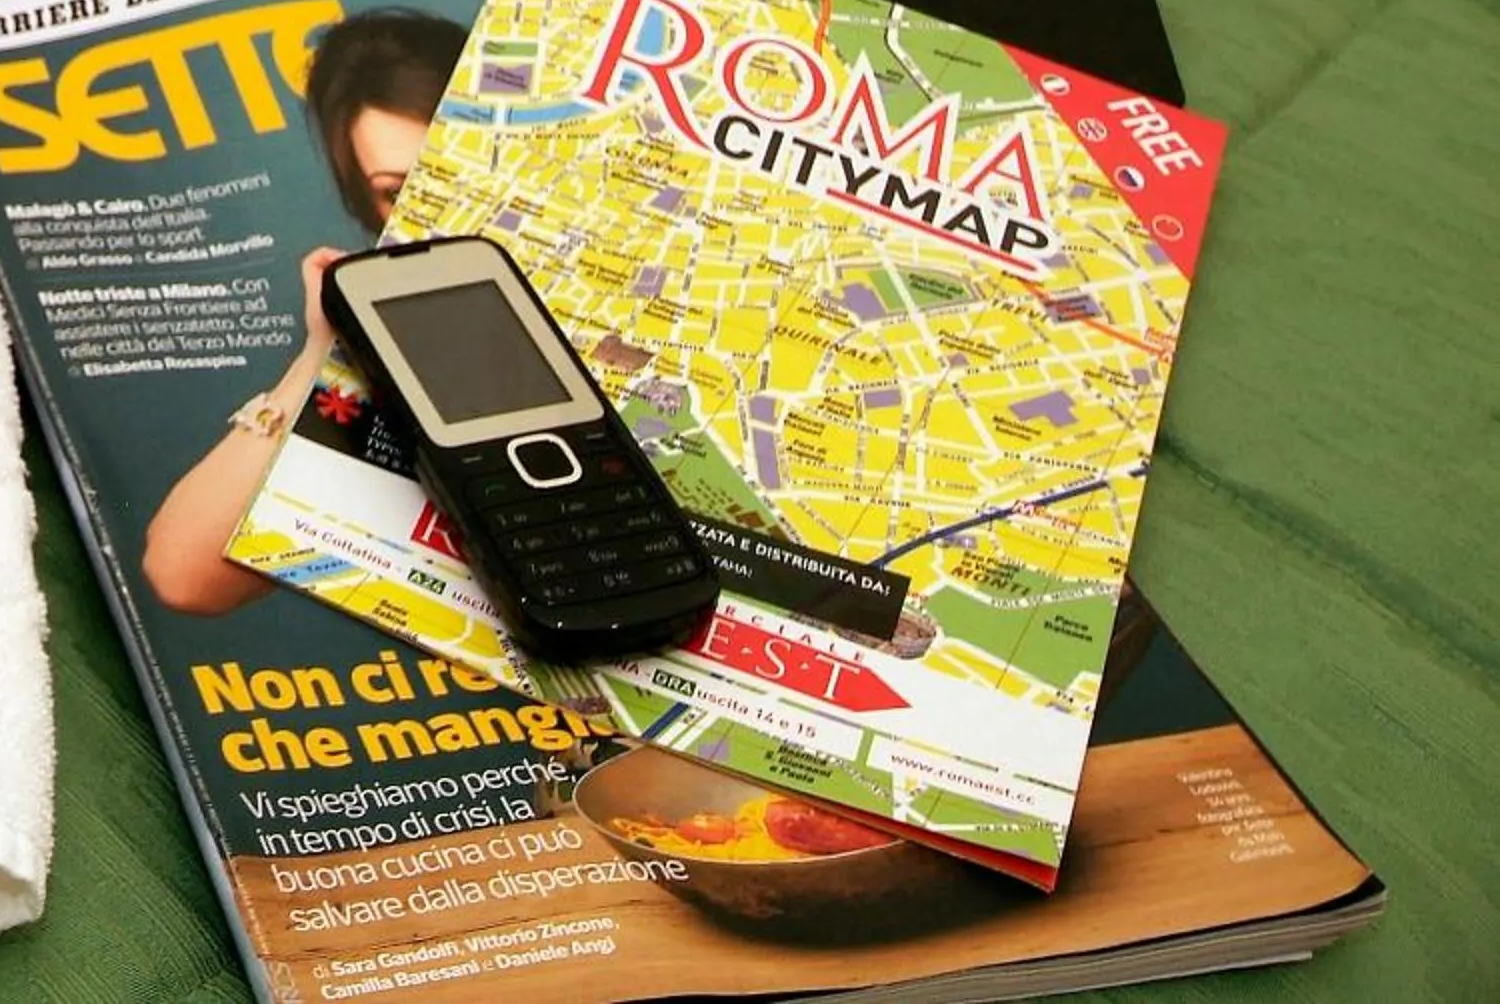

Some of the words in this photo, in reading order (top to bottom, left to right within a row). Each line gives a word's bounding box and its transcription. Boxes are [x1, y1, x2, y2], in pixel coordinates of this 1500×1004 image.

[1107, 95, 1204, 177] FREE
[148, 193, 186, 210] Due
[186, 171, 271, 203] fenomeni
[712, 114, 1050, 260] CITYMAP
[18, 233, 105, 253] Passando
[107, 234, 134, 249] per
[137, 231, 155, 246] lo
[39, 290, 94, 307] Notte
[94, 285, 147, 302] triste
[148, 287, 161, 300] a
[160, 282, 231, 299] Milano.
[232, 277, 269, 294] Con
[45, 305, 104, 323] Medici
[106, 302, 162, 319] Senza
[163, 298, 242, 317] Frontiere
[244, 296, 267, 313] ad
[54, 324, 132, 341] assistere
[240, 313, 295, 330] Come
[60, 342, 104, 359] nelle
[106, 337, 145, 354] città
[147, 335, 175, 351] del
[176, 333, 225, 350] Terzo
[226, 330, 292, 348] Mondo
[84, 357, 164, 376] Elisabetta
[292, 516, 318, 537] Via
[320, 529, 392, 572] Collatina
[741, 538, 751, 552] E
[755, 542, 857, 586] DISTRIBUITA
[190, 658, 346, 716] Non
[350, 650, 414, 702] ci
[697, 689, 750, 716] uscita
[756, 708, 774, 724] 14
[798, 722, 817, 739] 15
[221, 715, 357, 773] che
[240, 790, 276, 820] Vi
[277, 775, 458, 824] spieghiamo
[461, 756, 577, 799] perché,
[890, 753, 1037, 806] www.romaest.cc
[256, 827, 290, 856] in
[290, 817, 398, 856] tempo
[400, 812, 430, 841] di
[434, 799, 505, 834] crisi,
[501, 794, 536, 822] la
[270, 862, 378, 895] buona
[381, 842, 487, 881] cucina
[490, 834, 515, 861] ci
[517, 824, 583, 862] può
[289, 898, 406, 934] salvare
[408, 876, 486, 918] dalla
[488, 855, 690, 909] disperazione
[312, 963, 329, 981] di
[331, 957, 377, 979] Sara
[465, 927, 537, 955] Vittorio
[537, 915, 621, 944] Zincone,
[319, 975, 393, 1002] Camilla
[395, 959, 481, 989] Baresani
[483, 959, 494, 972] e
[494, 944, 569, 972] Daniele
[570, 935, 617, 961] Angi
